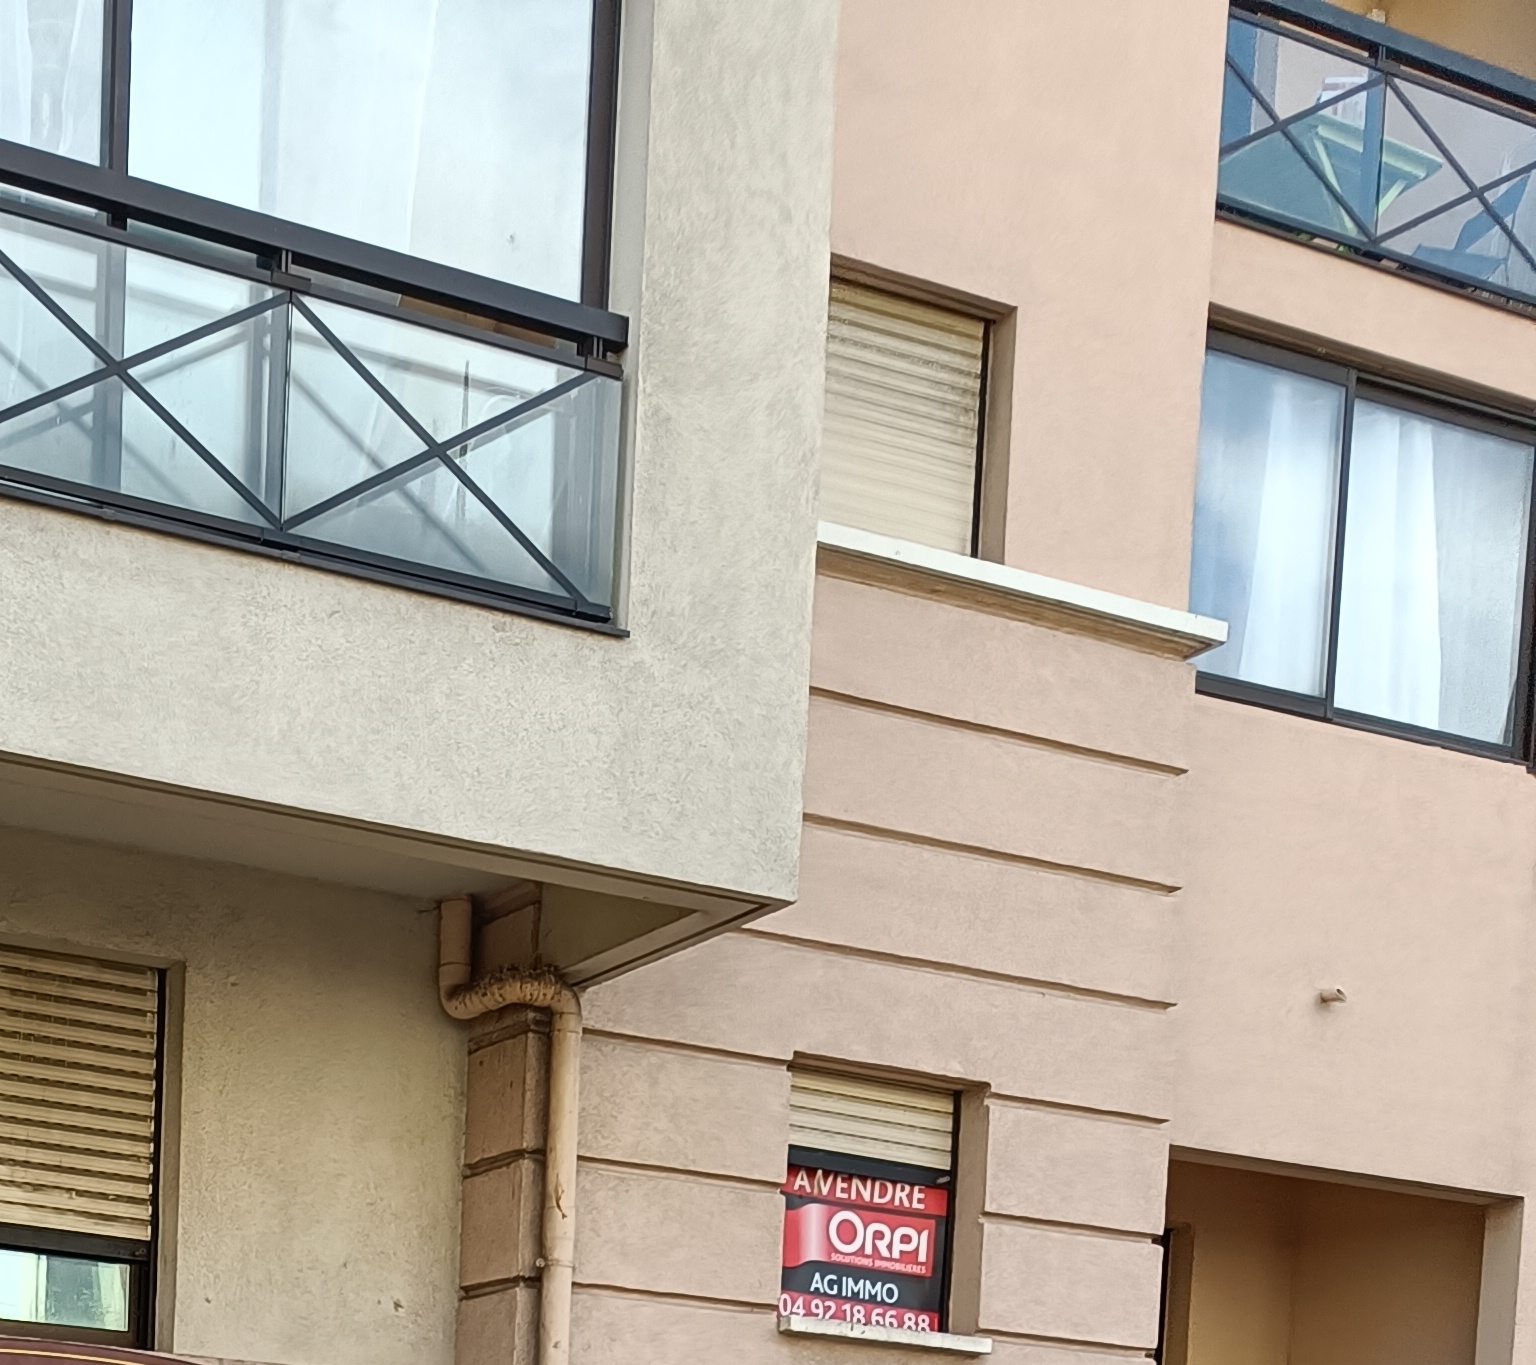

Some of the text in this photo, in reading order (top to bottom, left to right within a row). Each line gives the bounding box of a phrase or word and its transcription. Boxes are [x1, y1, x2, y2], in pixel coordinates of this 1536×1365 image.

[793, 1168, 926, 1210] A VENDRE
[829, 1210, 929, 1263] ORPI
[841, 1276, 899, 1304] IMMO
[779, 1293, 931, 1332] 04 92 18 66 88
